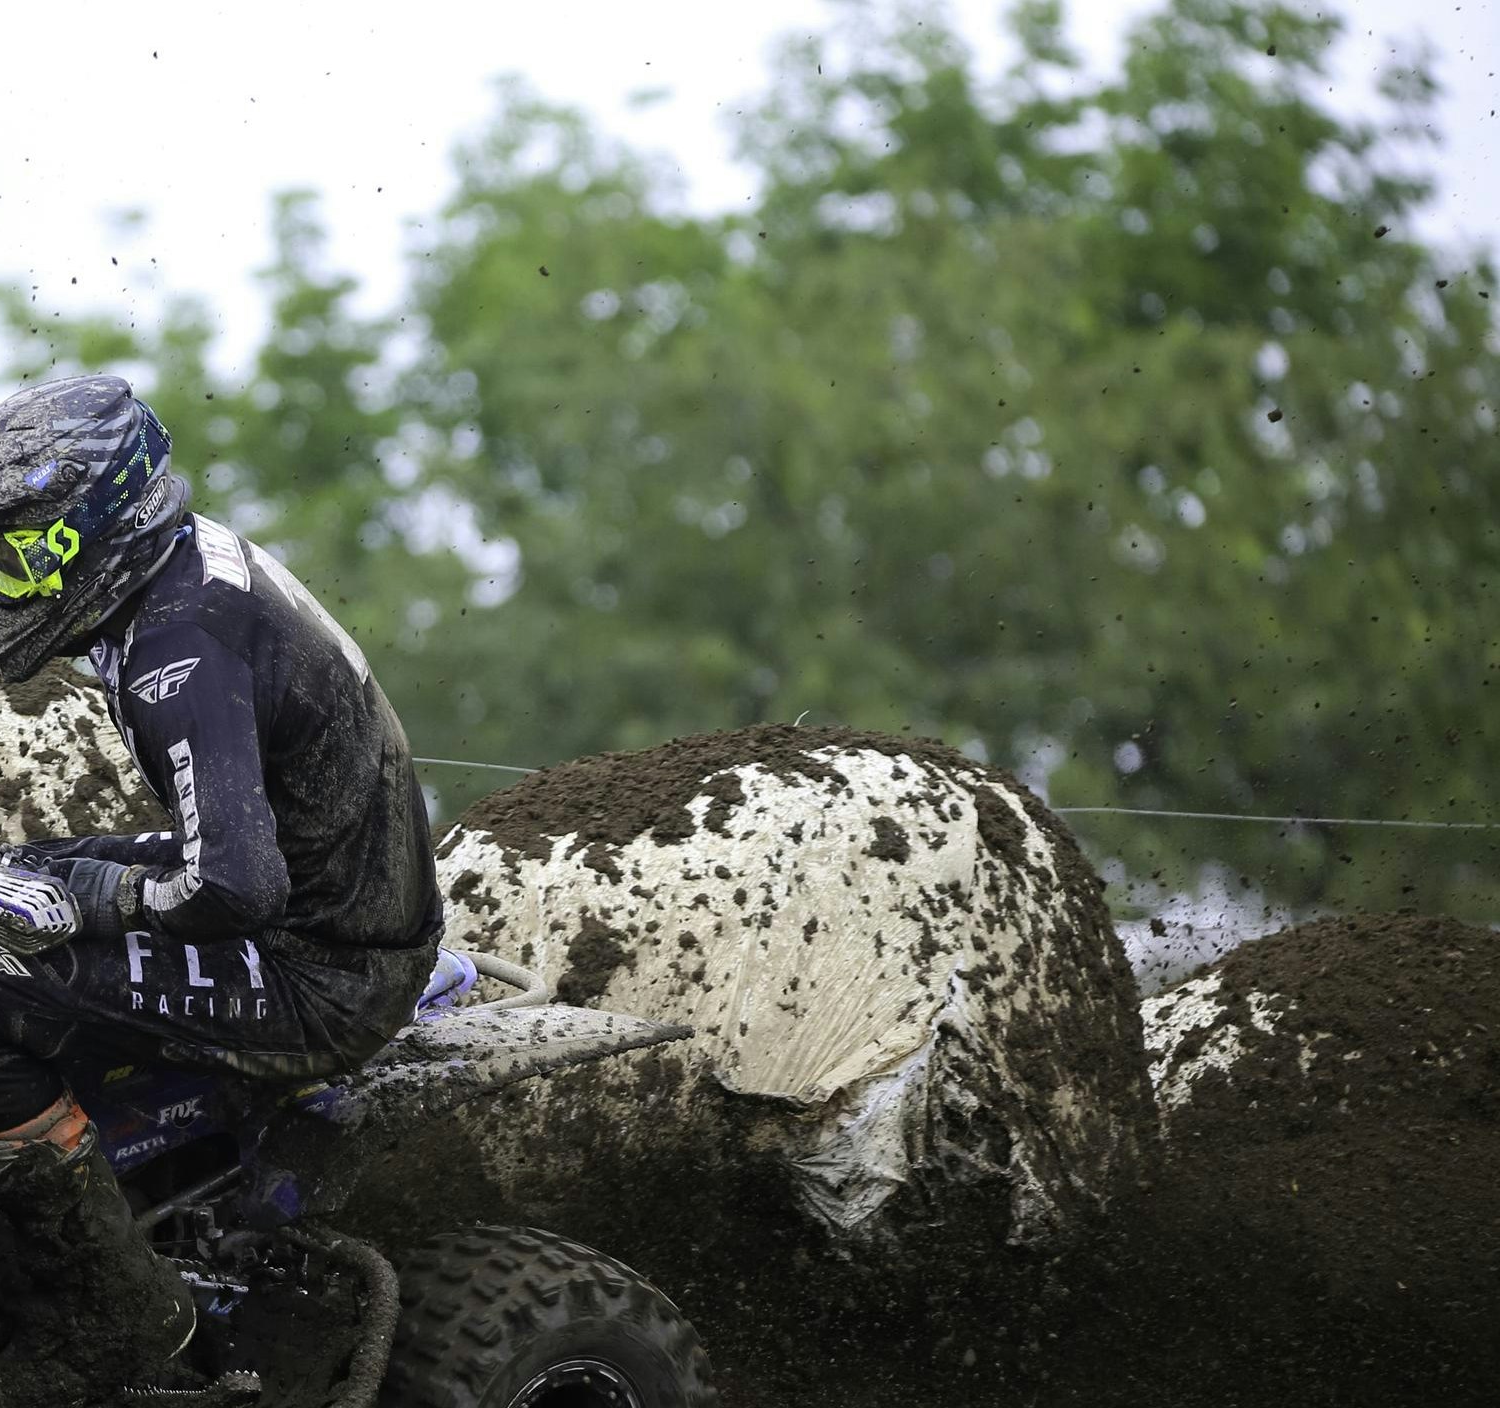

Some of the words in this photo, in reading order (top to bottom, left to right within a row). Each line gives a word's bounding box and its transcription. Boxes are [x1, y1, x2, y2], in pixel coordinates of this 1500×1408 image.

[125, 931, 264, 989] FLY
[132, 991, 267, 1020] RACING
[158, 1098, 203, 1126] FOX
